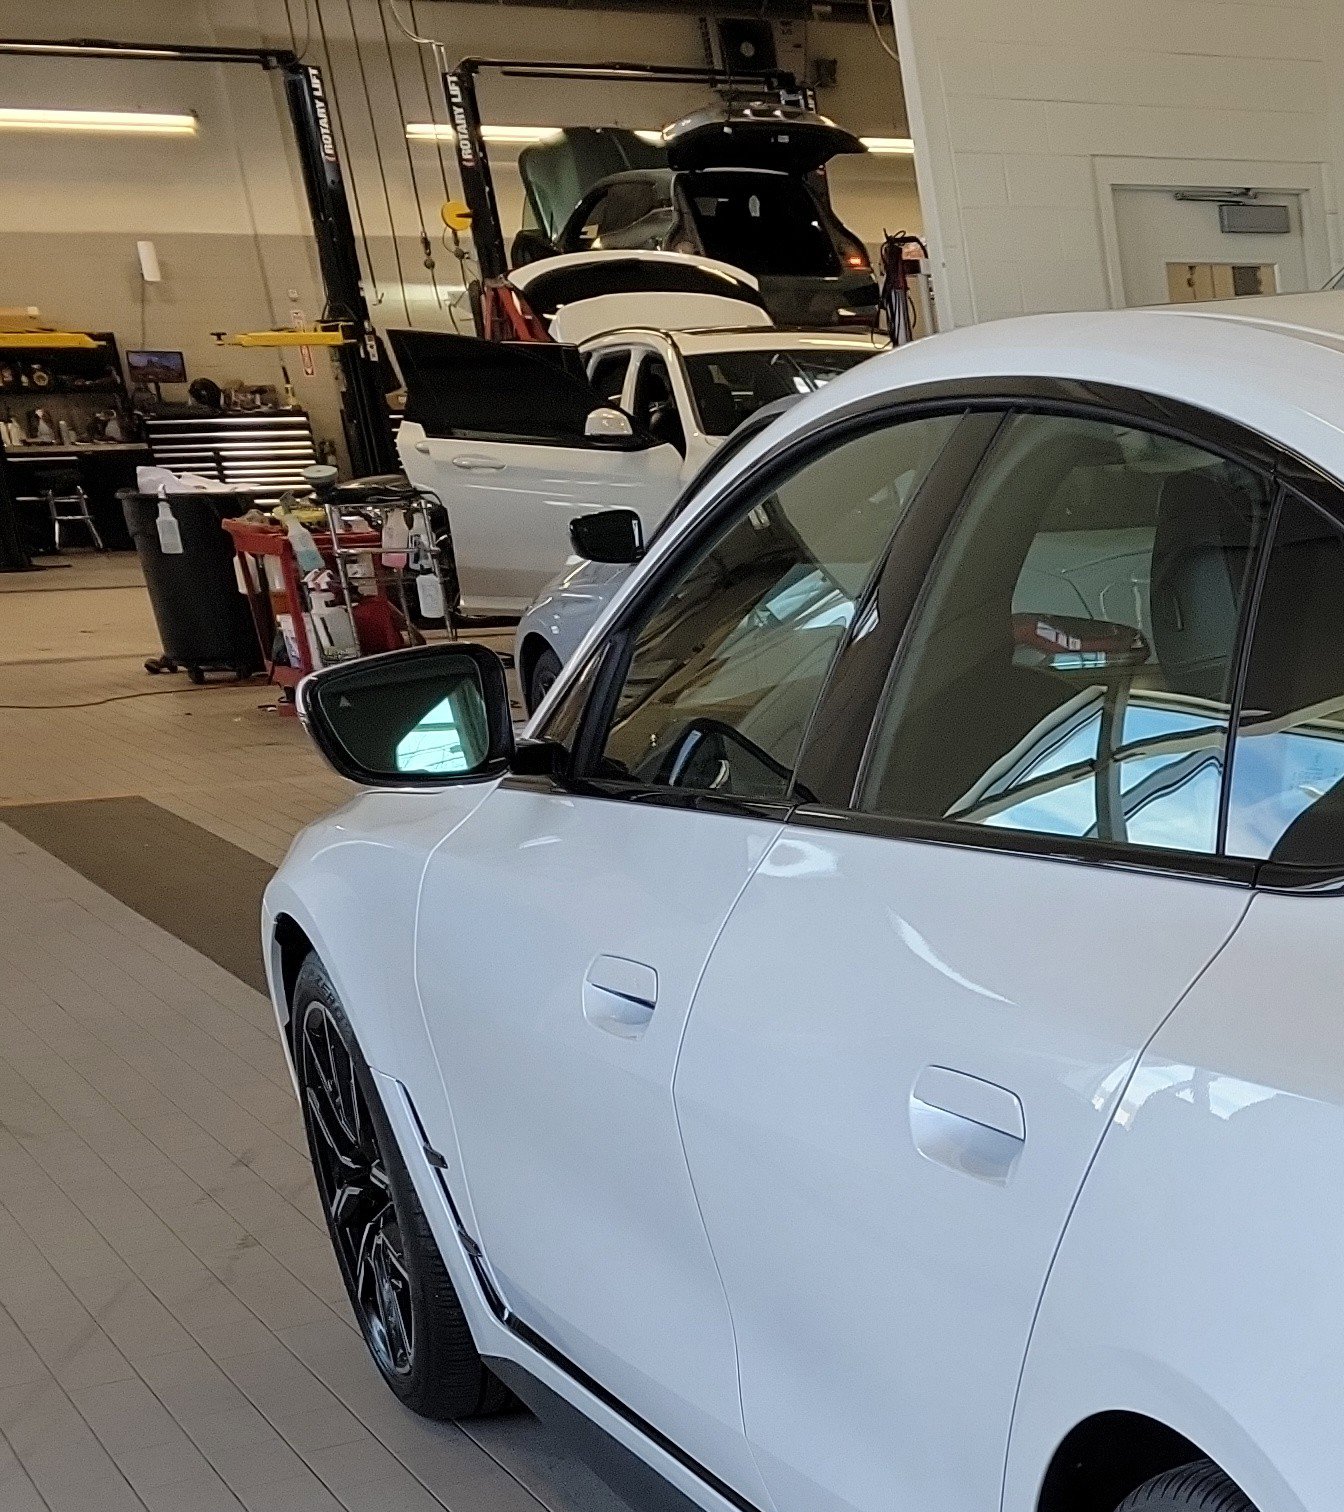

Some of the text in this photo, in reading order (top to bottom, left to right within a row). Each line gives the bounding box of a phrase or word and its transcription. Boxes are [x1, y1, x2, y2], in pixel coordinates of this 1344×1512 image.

[308, 66, 335, 154] ROTARY LIFT
[447, 75, 472, 159] ROTARY LIFT
